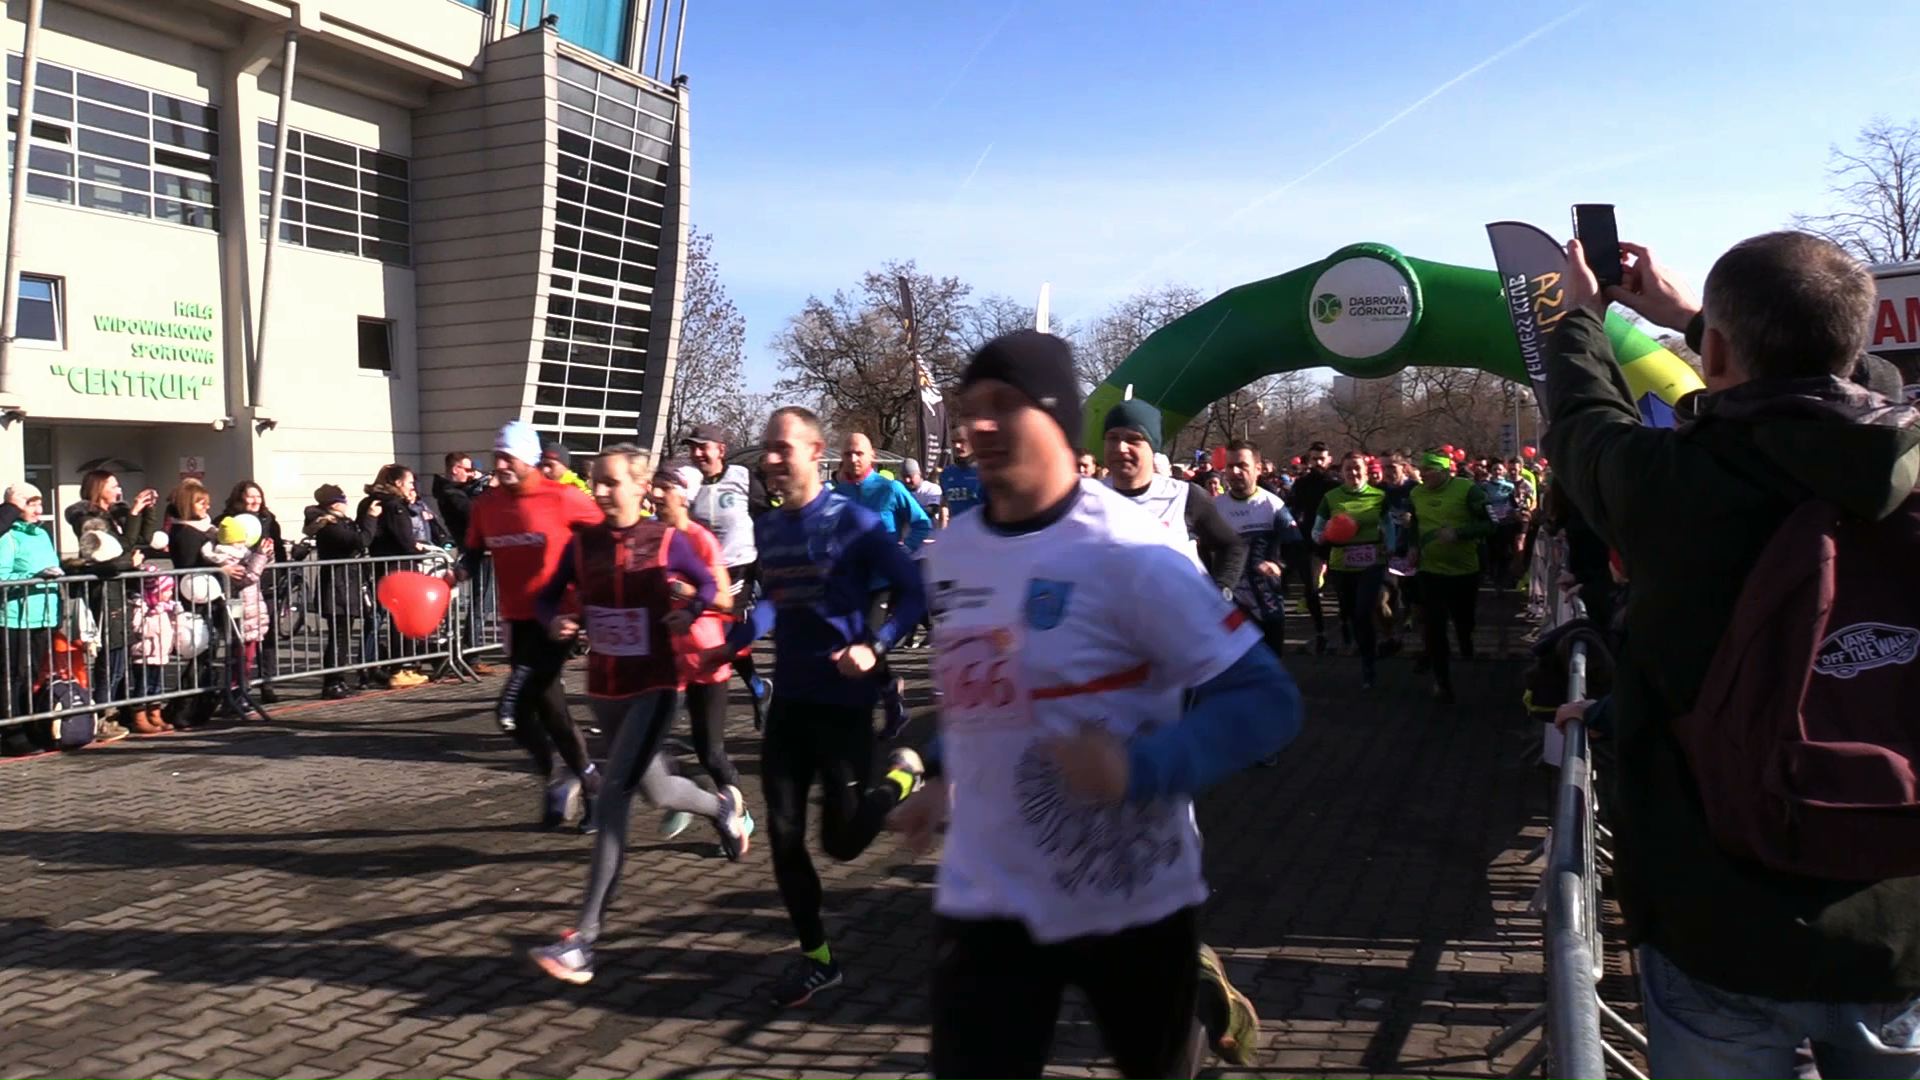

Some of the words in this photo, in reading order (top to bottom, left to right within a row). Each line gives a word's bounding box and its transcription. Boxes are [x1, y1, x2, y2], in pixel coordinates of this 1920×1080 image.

[174, 300, 213, 320] HALA
[93, 314, 213, 342] WIDOWISKOWO
[130, 342, 215, 365] SPORTOWA
[1822, 651, 1845, 665] OFF
[1848, 642, 1878, 661] THE
[1874, 633, 1909, 656] WALL
[1834, 627, 1877, 652] VANS
